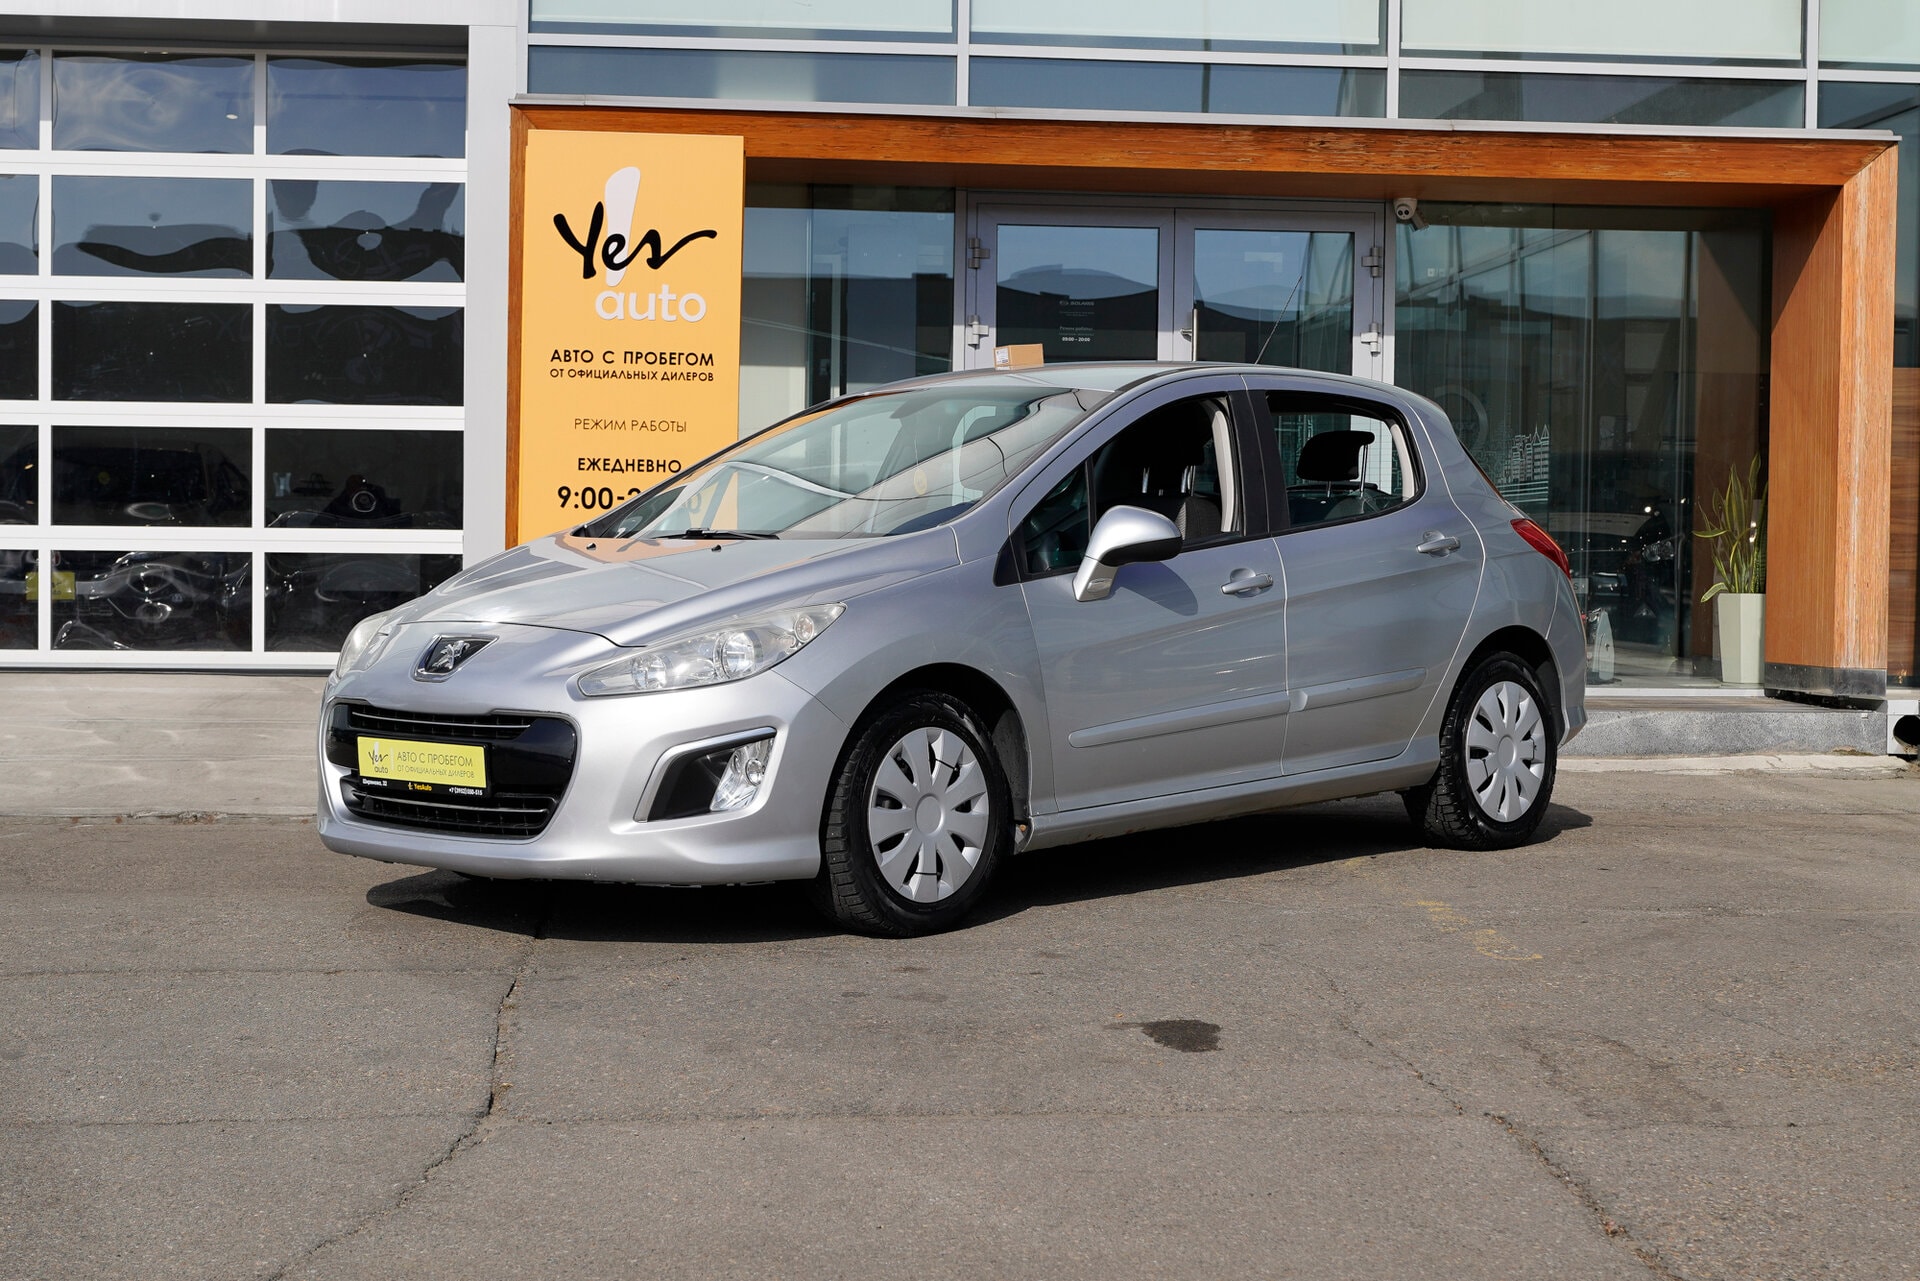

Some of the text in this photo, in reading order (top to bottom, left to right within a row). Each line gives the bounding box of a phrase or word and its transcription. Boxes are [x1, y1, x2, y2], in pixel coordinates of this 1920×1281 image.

[553, 201, 717, 280] Yes
[595, 284, 707, 323] auto
[550, 349, 714, 366] АВТО С ПРОБЕГОМ
[550, 368, 714, 382] ОТ ОФИЦИАЛЬНЫХ ДИЛЕРОВ
[574, 418, 687, 433] РЕЖИМ РАБОТЫ
[577, 457, 682, 473] ЕЖЕДНЕВНО
[397, 751, 473, 767] АВТО С ПРОБЕГОМ
[374, 765, 389, 774] auto
[397, 764, 475, 779] ОТ ОФИЦИАЛЬНЫХ ДИЛЕРОВ
